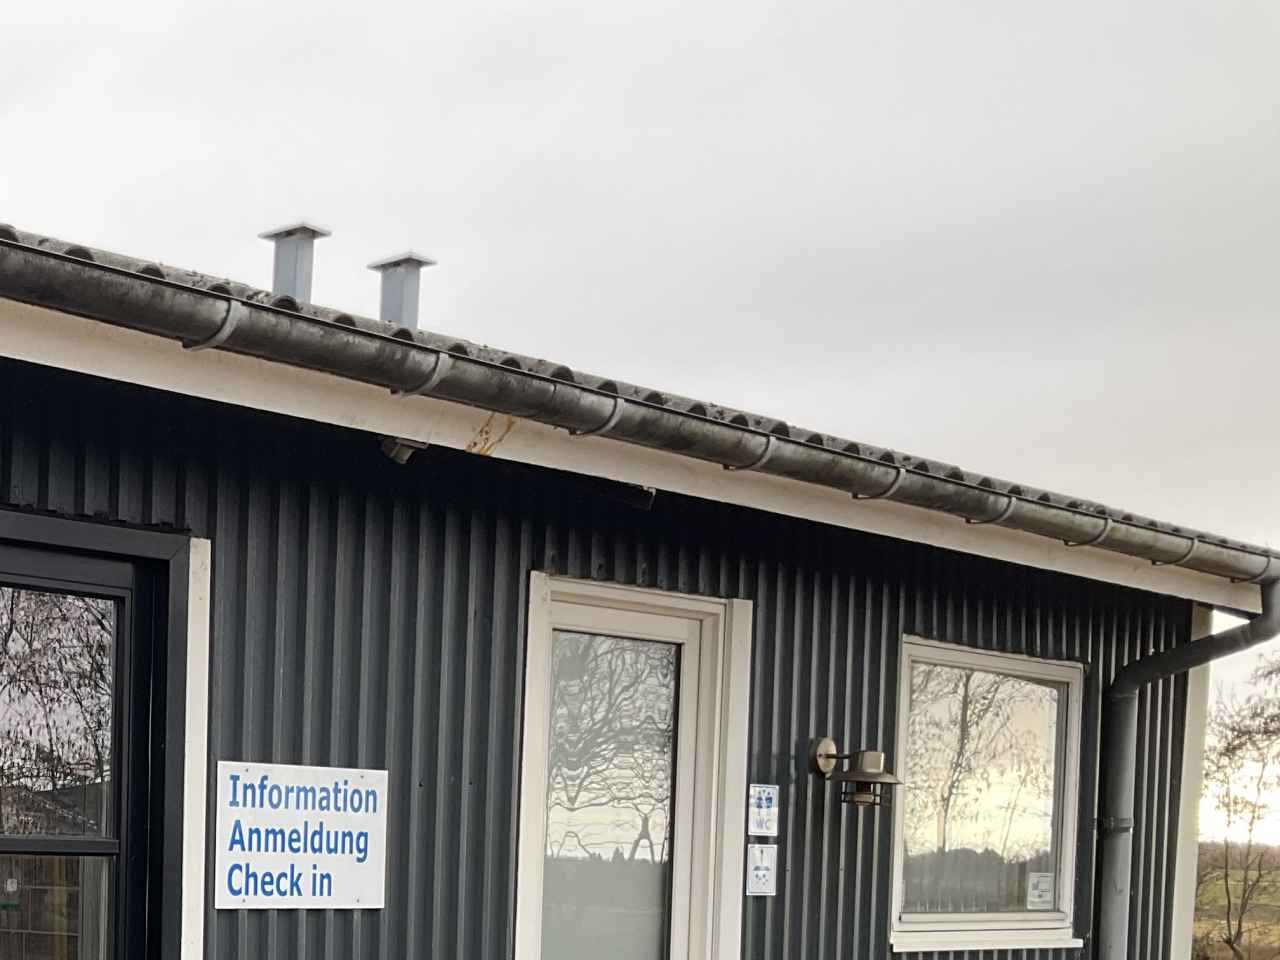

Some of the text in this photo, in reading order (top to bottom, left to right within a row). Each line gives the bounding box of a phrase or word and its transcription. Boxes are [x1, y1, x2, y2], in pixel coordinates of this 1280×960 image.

[229, 774, 377, 813] Information
[228, 820, 369, 863] Anmeldung
[755, 818, 771, 830] WC
[227, 863, 332, 897] Check in
